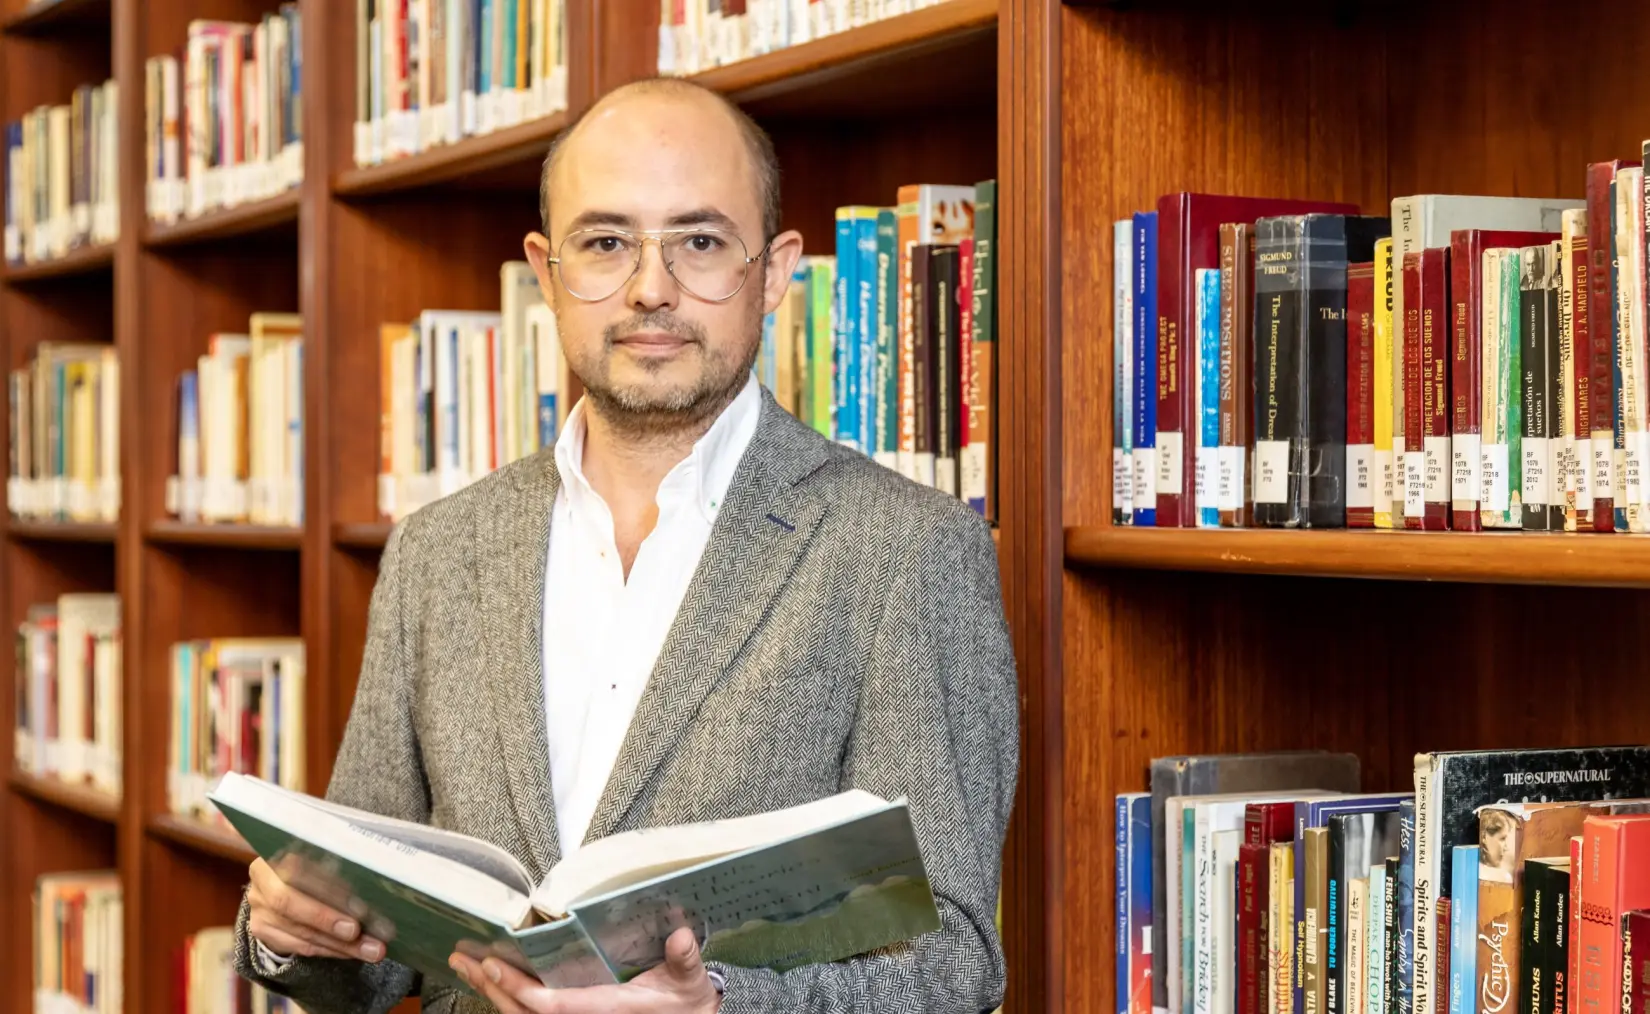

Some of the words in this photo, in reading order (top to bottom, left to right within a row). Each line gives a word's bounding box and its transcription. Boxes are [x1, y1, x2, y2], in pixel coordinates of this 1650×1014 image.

[1402, 206, 1412, 232] The
[1260, 252, 1292, 262] SIGMUND
[1264, 264, 1287, 275] FREUD
[1564, 290, 1572, 308] On
[1578, 264, 1587, 312] HADFIELD
[1270, 294, 1280, 318] The
[1320, 308, 1339, 320] The
[1456, 302, 1466, 324] Freud
[1578, 315, 1587, 324] A.
[1578, 325, 1588, 334] J.
[1564, 312, 1572, 362] Dreams
[1221, 306, 1232, 401] POSITIONS
[1268, 320, 1279, 392] Interpretation
[1424, 346, 1432, 363] LOS
[1424, 366, 1432, 378] DE
[1435, 360, 1443, 380] Freud
[1525, 370, 1532, 384] de
[1268, 396, 1277, 408] of
[1524, 386, 1534, 438] rpretación
[1579, 376, 1588, 437] NIGHTMARES
[1534, 399, 1542, 434] sueños
[1503, 772, 1524, 786] THE
[1534, 769, 1611, 786] SUPERNATURAL
[1119, 833, 1126, 842] to
[1400, 816, 1416, 850] Hess
[1419, 802, 1427, 866] SUPERNATURAL
[1119, 890, 1127, 913] Your
[1200, 858, 1210, 923] Search
[1416, 878, 1430, 922] Spirits
[1416, 926, 1428, 948] and
[1437, 922, 1446, 976] CASTELLAN
[1329, 957, 1336, 968] TU
[1398, 928, 1415, 973] Samba
[1478, 920, 1509, 992] Psychic
[1196, 950, 1210, 1011] Bridey
[1307, 972, 1315, 980] Y
[1414, 952, 1428, 989] Spirit
[1624, 954, 1632, 993] ROOTS
[1437, 978, 1445, 1012] YVONNE
[1452, 972, 1461, 1012] Fingers
[1622, 994, 1632, 1012] OF
